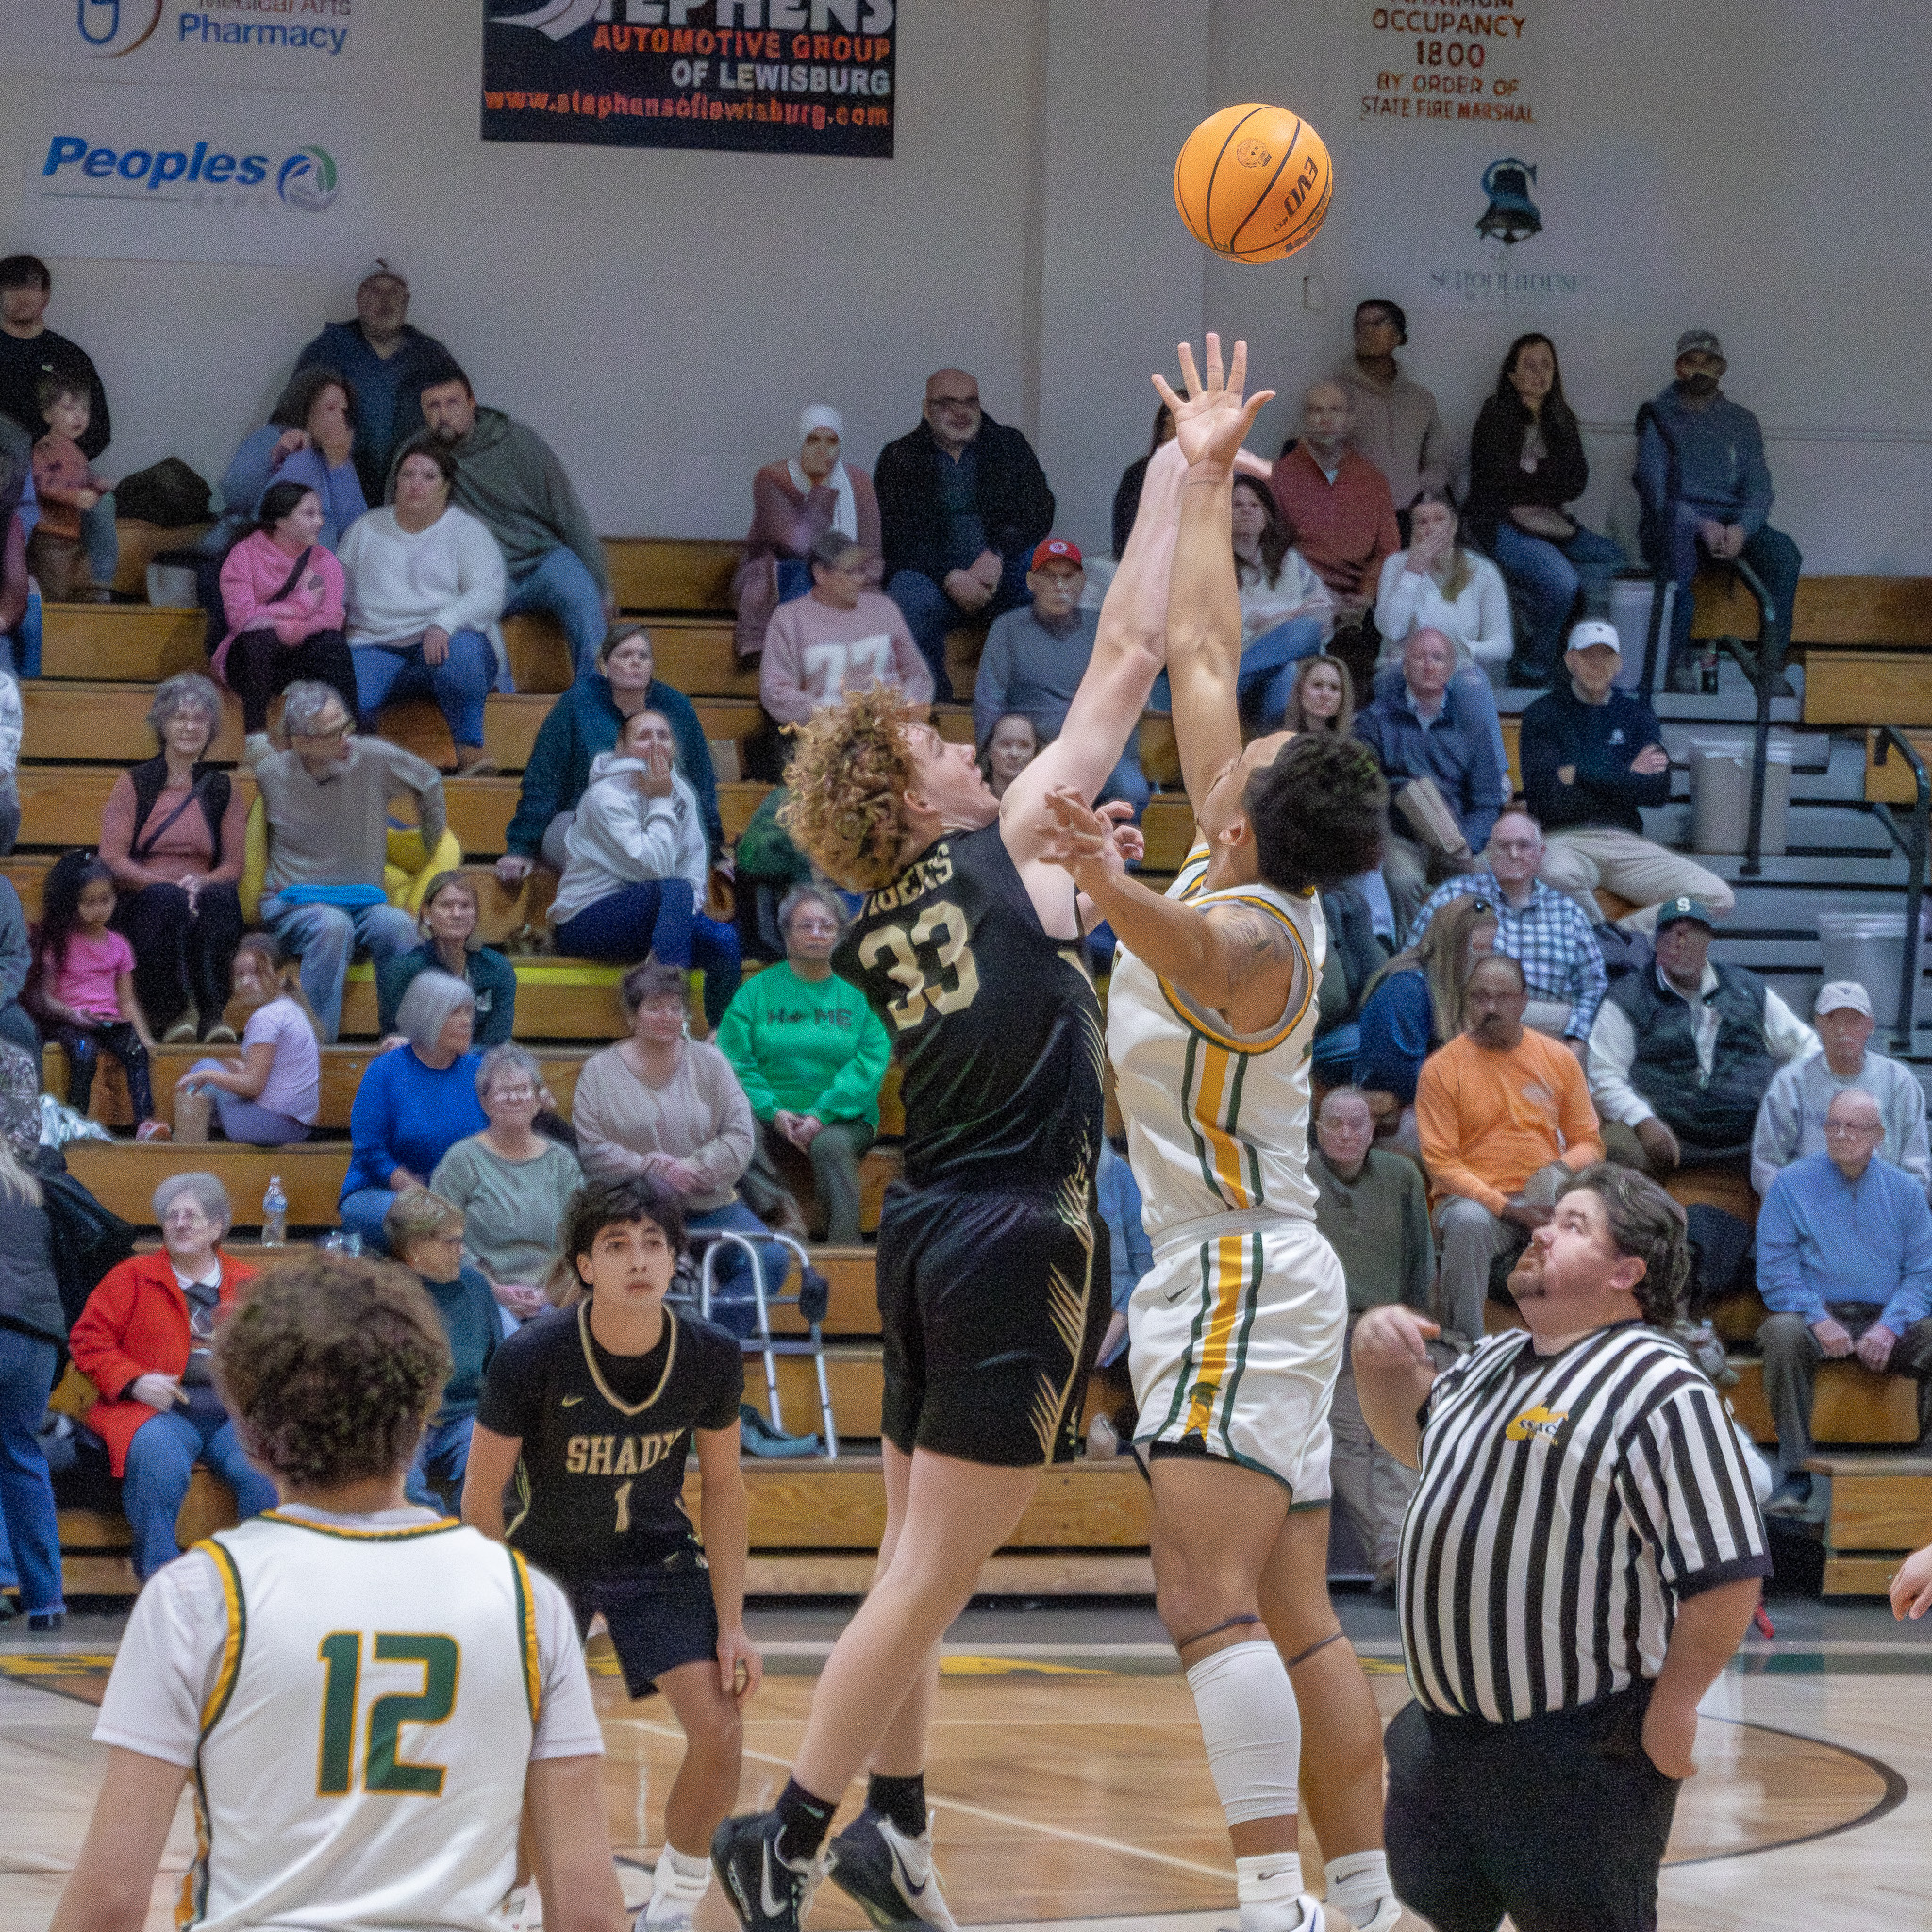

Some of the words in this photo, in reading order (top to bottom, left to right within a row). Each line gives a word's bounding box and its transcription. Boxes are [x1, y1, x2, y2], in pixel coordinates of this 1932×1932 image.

[179, 13, 348, 56] Pharmacy
[1372, 8, 1526, 39] OCCUPANCY
[592, 25, 781, 58] AUTOMOTIVE
[792, 34, 890, 62] GROUP
[1415, 39, 1486, 69] 1800
[671, 59, 708, 88] OF
[719, 61, 891, 96] LEWISBURG
[1376, 71, 1405, 92] BY
[1412, 74, 1484, 95] ORDER
[1492, 78, 1521, 97] OF
[483, 90, 889, 130] www.stephensoflewisburg.com
[1361, 96, 1409, 121] STATE
[1416, 99, 1452, 120] FIRE
[1457, 102, 1537, 124] MARSHAL
[42, 136, 270, 189] Peoples
[1283, 156, 1319, 218] EVO
[1677, 897, 1690, 912] S
[858, 899, 980, 1032] 33
[768, 1008, 853, 1028] HME
[566, 1427, 686, 1476] SHADY
[614, 1480, 633, 1533] 1
[314, 1629, 463, 1799] 12
